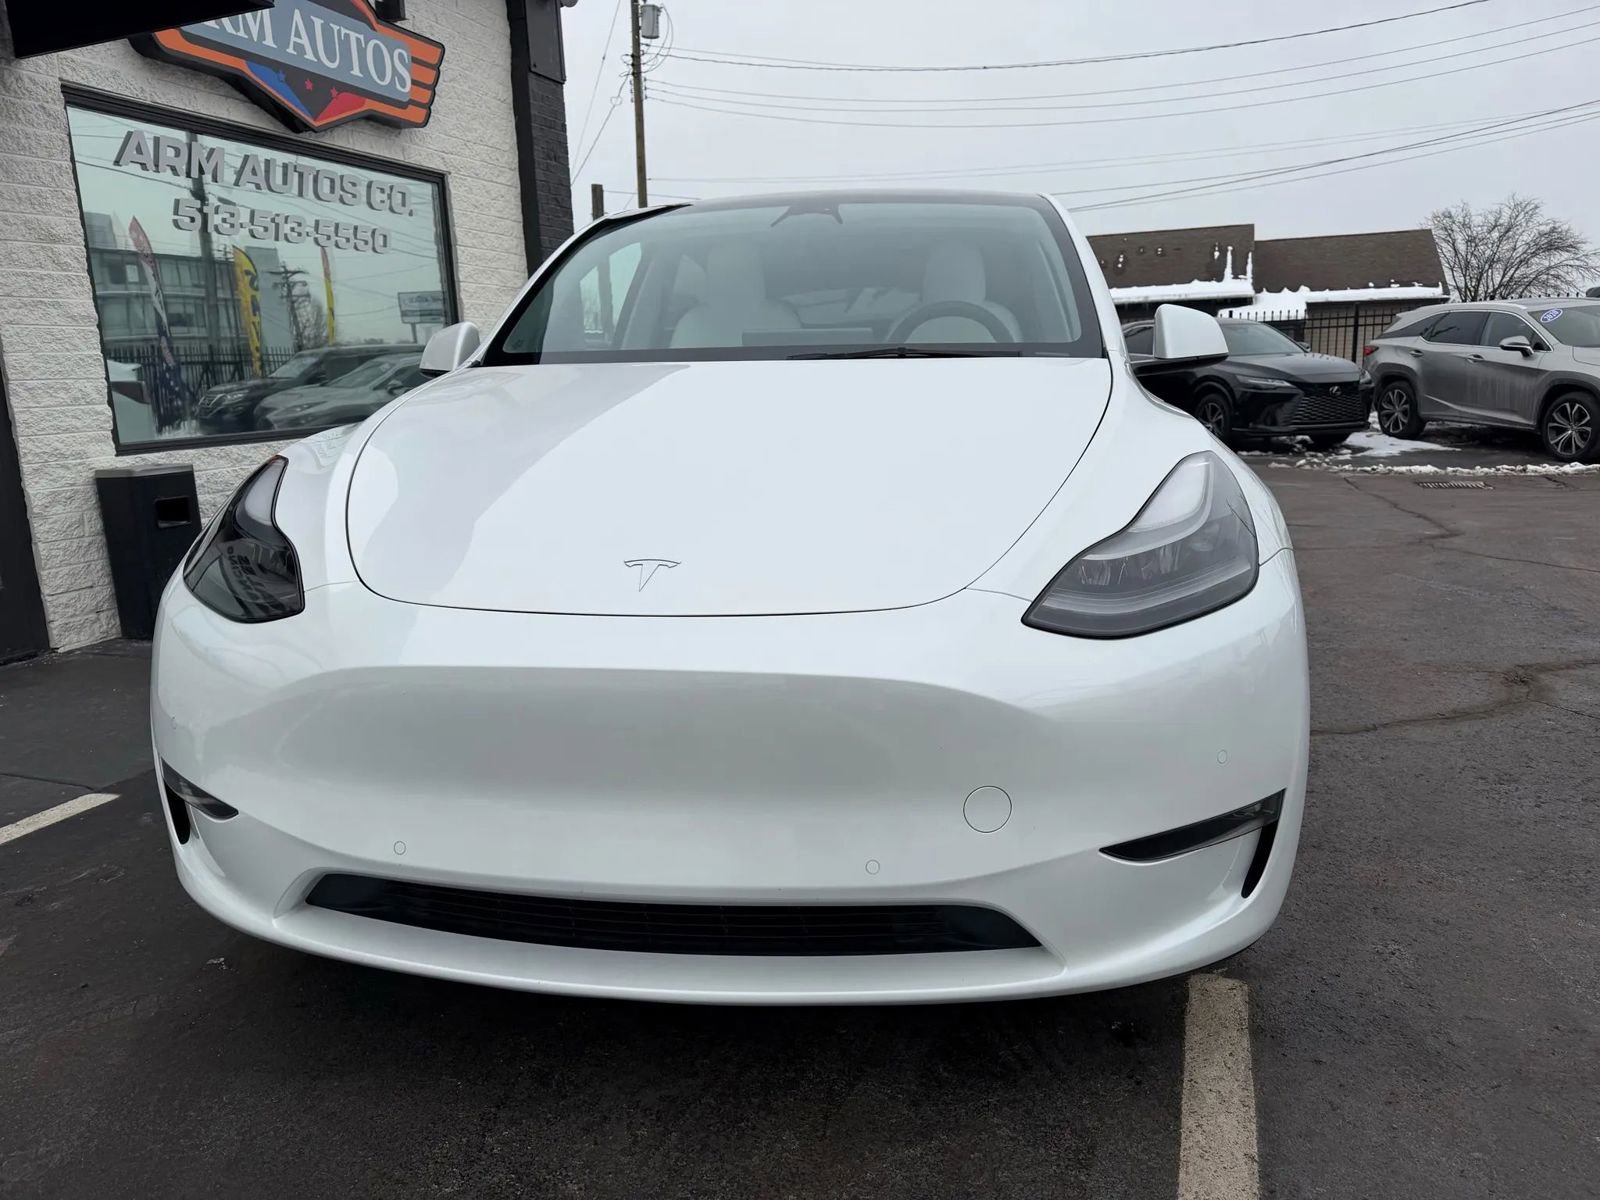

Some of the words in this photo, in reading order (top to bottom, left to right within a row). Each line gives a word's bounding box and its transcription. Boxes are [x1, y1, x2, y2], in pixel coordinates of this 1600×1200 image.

[286, 7, 411, 93] AUTOS
[113, 129, 225, 183] ARM
[233, 153, 362, 207] AUTOS
[366, 179, 417, 217] CO.
[172, 198, 392, 255] 513-513-5550
